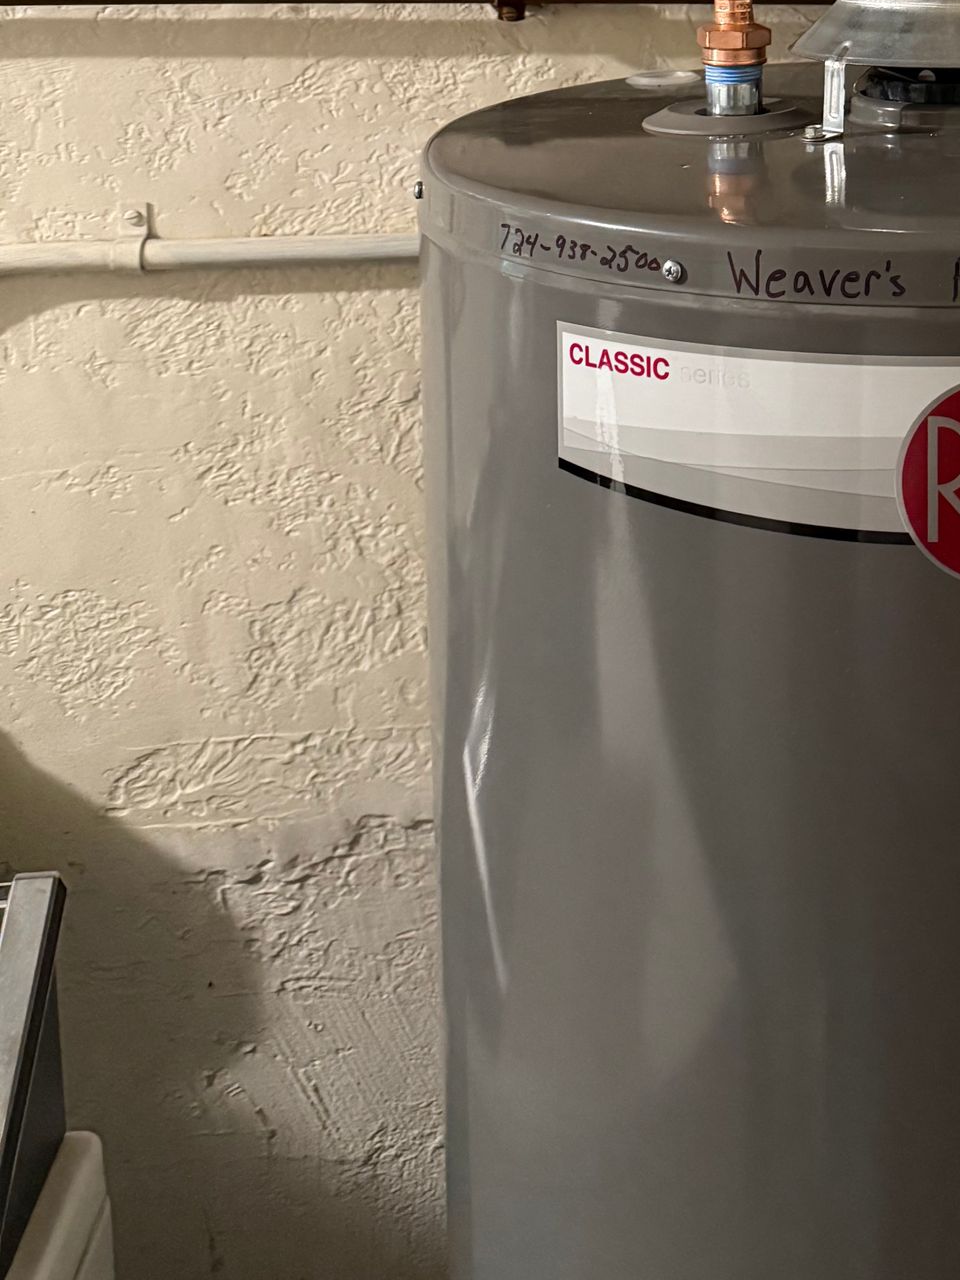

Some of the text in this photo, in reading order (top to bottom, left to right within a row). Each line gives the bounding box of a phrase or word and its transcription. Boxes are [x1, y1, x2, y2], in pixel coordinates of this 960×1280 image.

[501, 223, 661, 272] 724-938-2500
[727, 249, 906, 298] Weaver's
[569, 342, 670, 380] CLASSIC
